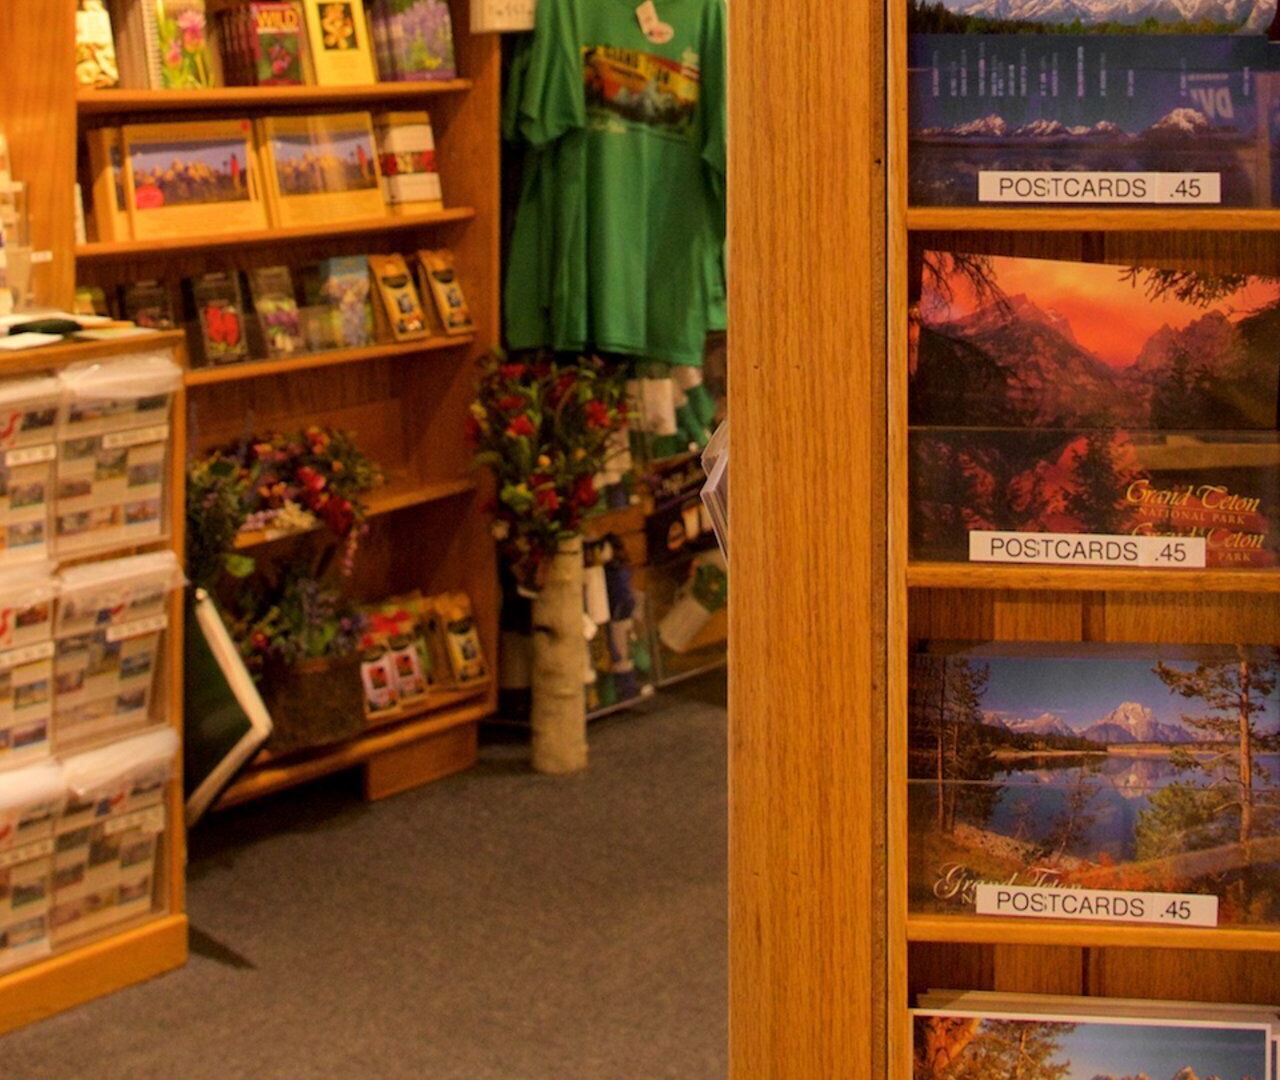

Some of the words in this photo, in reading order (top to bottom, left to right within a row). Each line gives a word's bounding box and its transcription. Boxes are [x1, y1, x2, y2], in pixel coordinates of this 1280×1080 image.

[999, 177, 1147, 199] POSTCARDS
[1169, 178, 1202, 199] .45
[1126, 479, 1194, 507] Grand
[1196, 484, 1261, 513] Teton
[1140, 508, 1206, 522] NATIONAL
[1212, 513, 1246, 525] PARK
[990, 537, 1139, 563] POSTCARDS
[1154, 542, 1187, 563] .45
[1218, 551, 1252, 562] PARK
[997, 891, 1145, 918] POSTCARDS
[1160, 900, 1192, 920] .45
